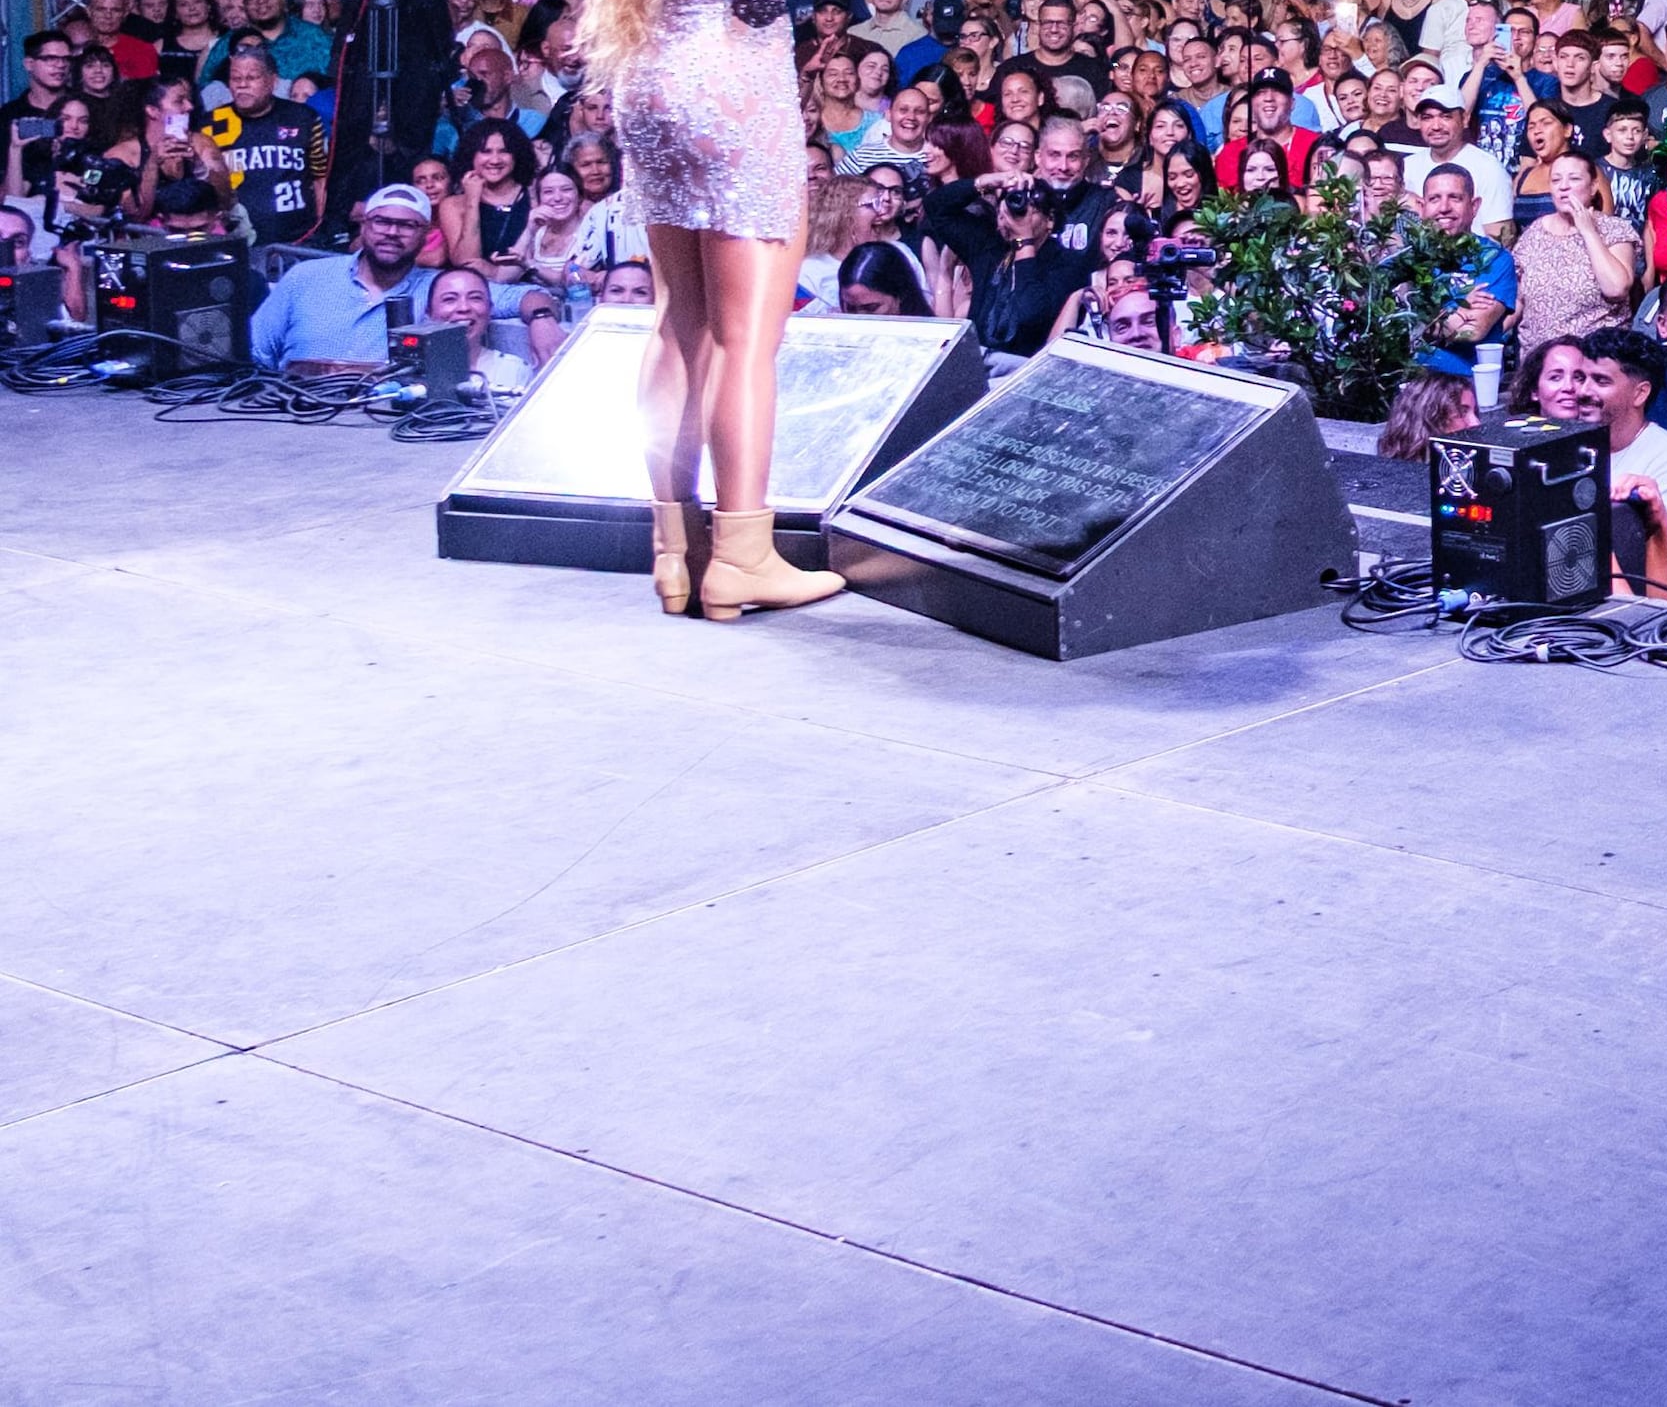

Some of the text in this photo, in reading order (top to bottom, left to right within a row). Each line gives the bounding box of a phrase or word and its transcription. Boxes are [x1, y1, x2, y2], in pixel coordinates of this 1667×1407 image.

[274, 180, 306, 213] 21
[1022, 443, 1102, 475] BUSCANDO
[974, 472, 1013, 492] DAS
[999, 479, 1054, 505] VALOR
[1048, 472, 1095, 494] TRAS
